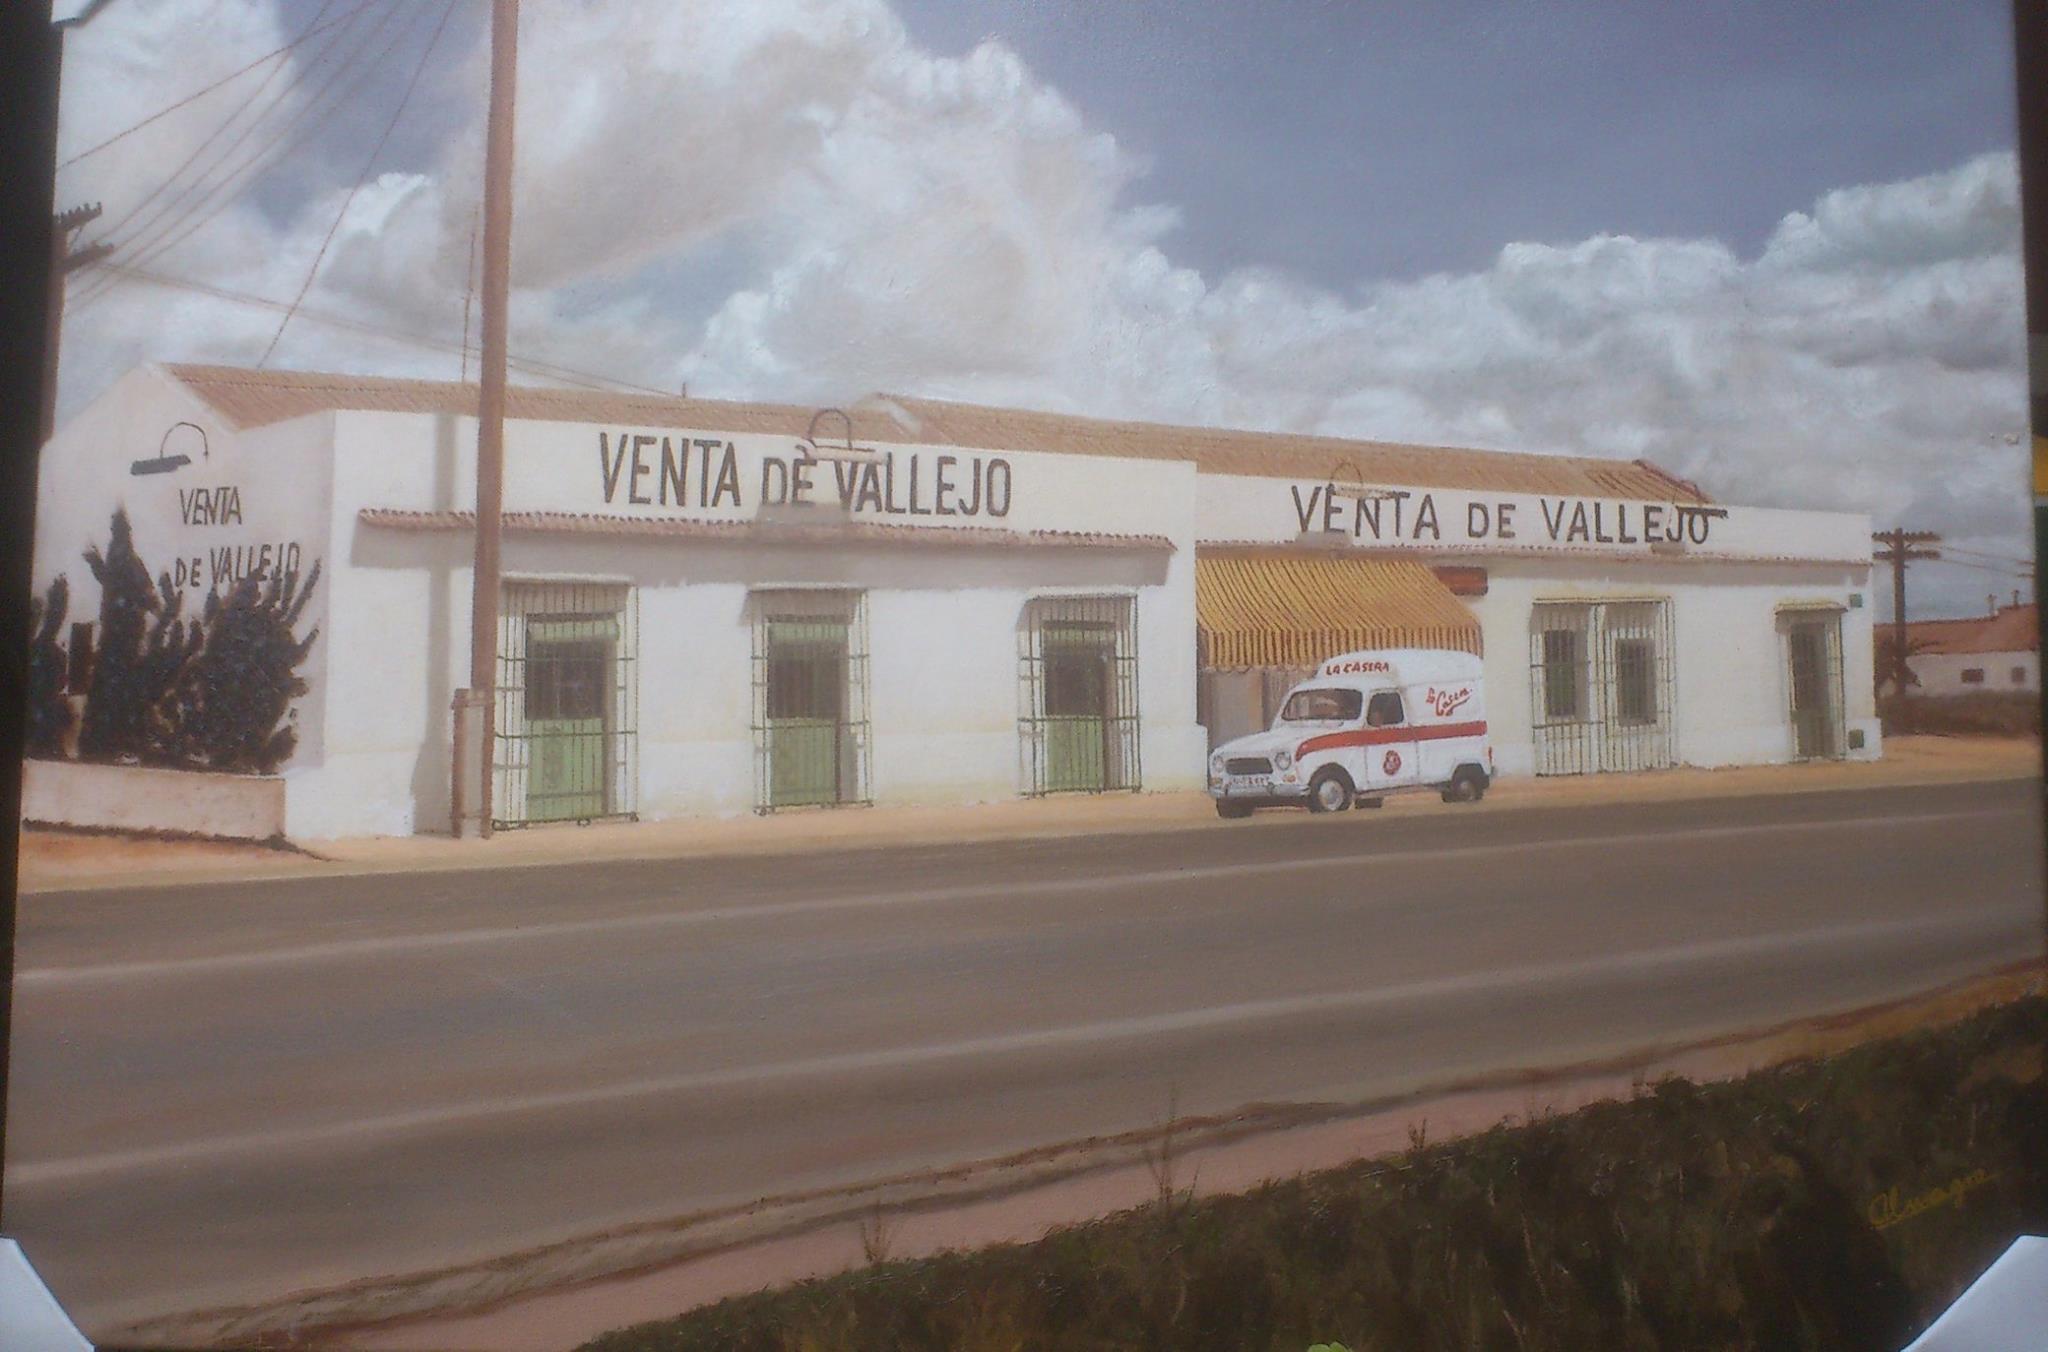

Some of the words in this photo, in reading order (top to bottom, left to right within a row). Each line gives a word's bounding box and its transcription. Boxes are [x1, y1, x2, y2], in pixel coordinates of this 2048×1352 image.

[600, 432, 742, 507] VENTA
[761, 457, 818, 507] DE
[834, 450, 1012, 518] VALLEJO
[179, 486, 243, 525] VENTA
[1291, 484, 1441, 539] VENTA
[1467, 502, 1516, 539] DE
[1540, 498, 1712, 545] VALLEJO
[175, 557, 202, 588] DE
[210, 541, 301, 586] VALLEJO
[1325, 664, 1341, 676] LA
[1343, 661, 1390, 674] CASERA
